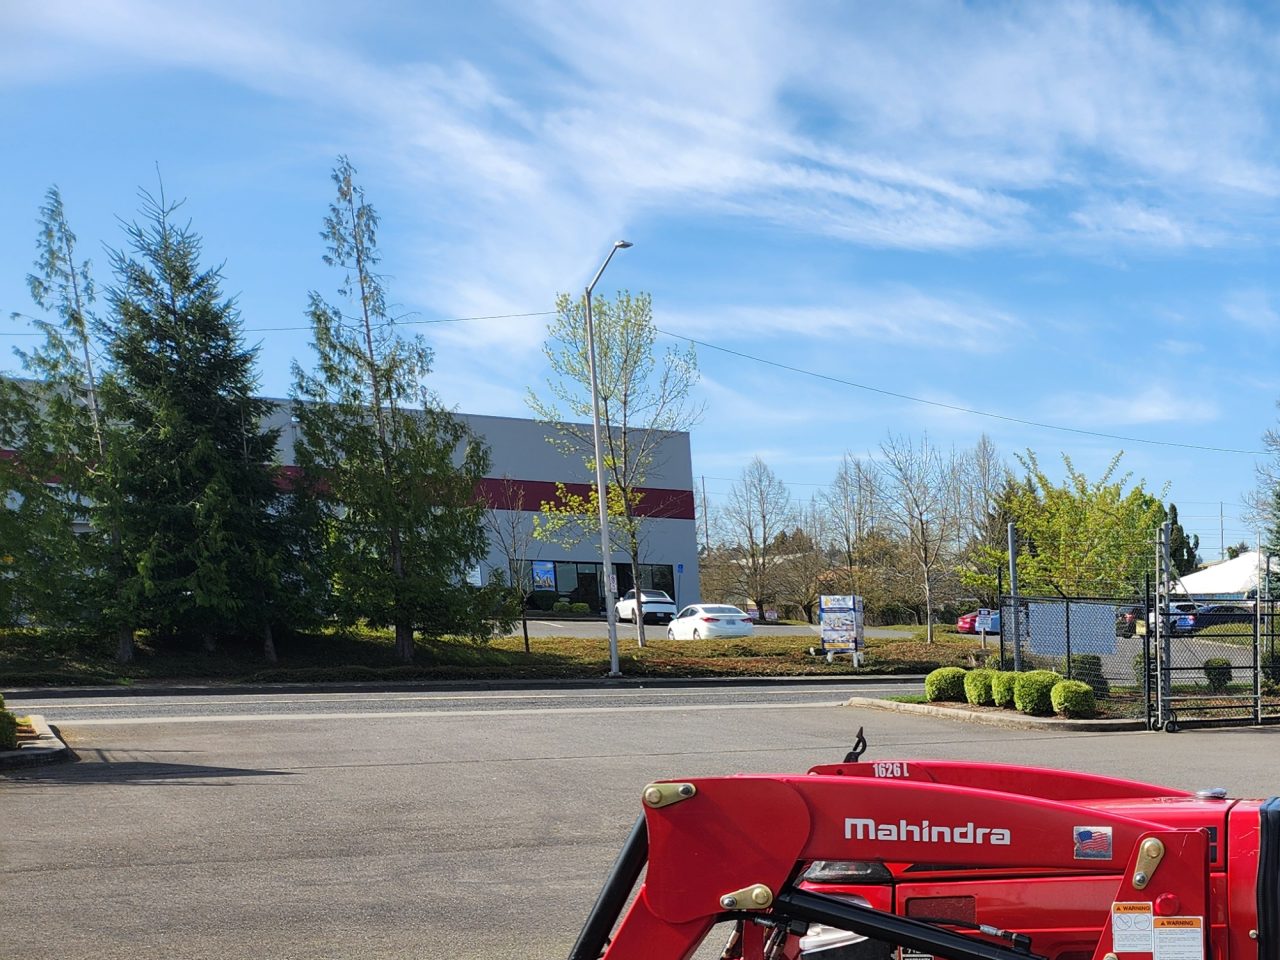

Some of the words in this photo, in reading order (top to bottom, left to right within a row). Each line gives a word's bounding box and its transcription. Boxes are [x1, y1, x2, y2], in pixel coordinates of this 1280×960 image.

[872, 763, 901, 777] 1626
[903, 762, 909, 776] L
[845, 818, 1011, 845] Mahindra
